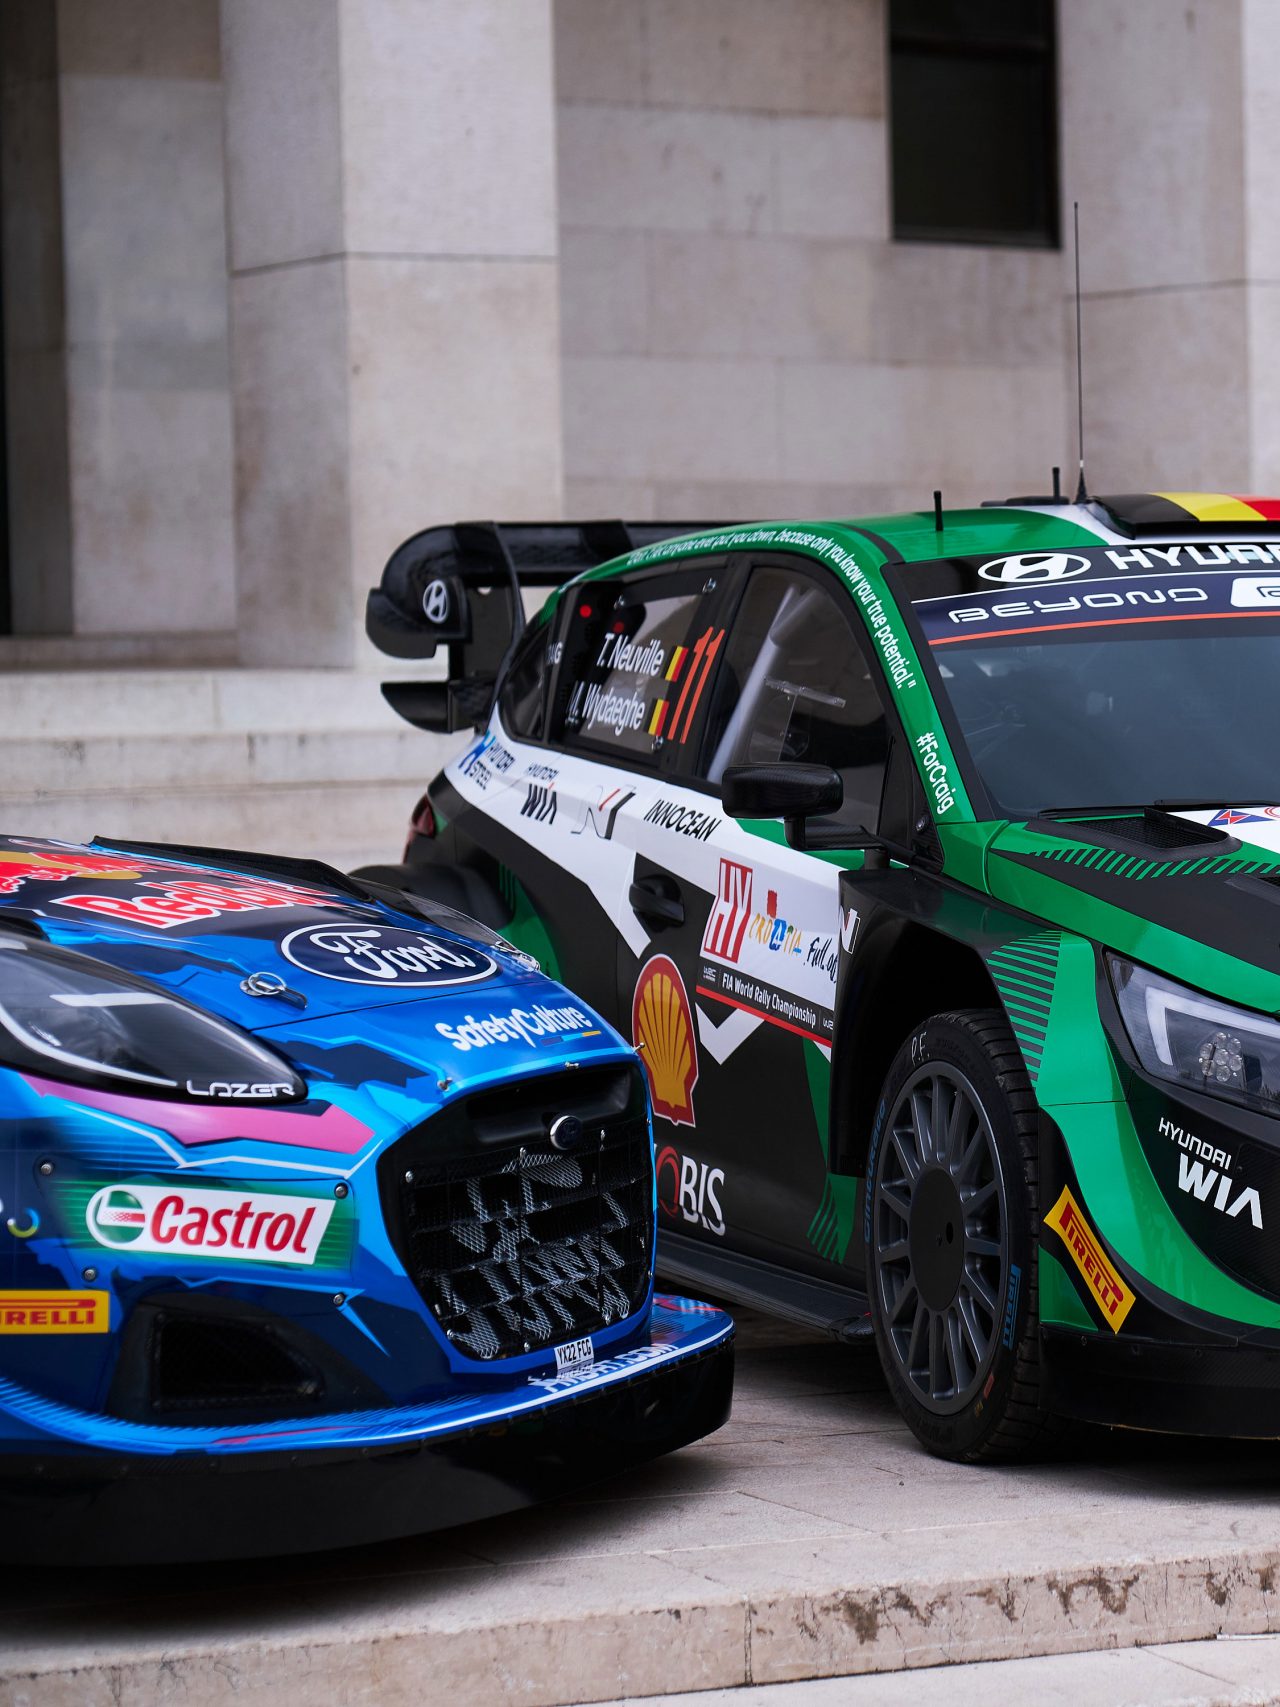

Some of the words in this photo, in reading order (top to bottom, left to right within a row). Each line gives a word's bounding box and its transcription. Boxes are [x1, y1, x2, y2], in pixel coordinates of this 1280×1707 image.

[775, 528, 814, 547] because
[811, 535, 834, 554] only
[825, 543, 846, 564] you
[839, 553, 865, 584] know
[853, 577, 876, 606] your
[867, 599, 887, 629] true
[948, 587, 1209, 623] BEYOND
[596, 632, 615, 667] T.
[607, 634, 664, 676] Neuville
[581, 682, 646, 736] Wydaeghe
[667, 626, 725, 744] 11
[916, 732, 956, 815] #ForCraig
[520, 782, 558, 825] WIA
[643, 798, 722, 842] INNOCEAN
[309, 929, 472, 979] Ford
[806, 936, 833, 970] Full
[722, 972, 733, 990] FIA
[734, 976, 754, 999] World
[754, 984, 772, 1009] Rally
[772, 993, 817, 1030] Championship
[434, 1004, 593, 1052] SafetyCulture
[186, 1080, 295, 1098] LAZER
[1158, 1116, 1232, 1171] HYUNDAI
[653, 1143, 726, 1237] OBIS
[1178, 1152, 1263, 1230] WIA
[151, 1194, 317, 1254] Castrol
[1058, 1200, 1124, 1317] PIRELLI
[0, 1299, 96, 1325] RELLI
[557, 1345, 576, 1365] YX22
[576, 1338, 592, 1359] FCG
